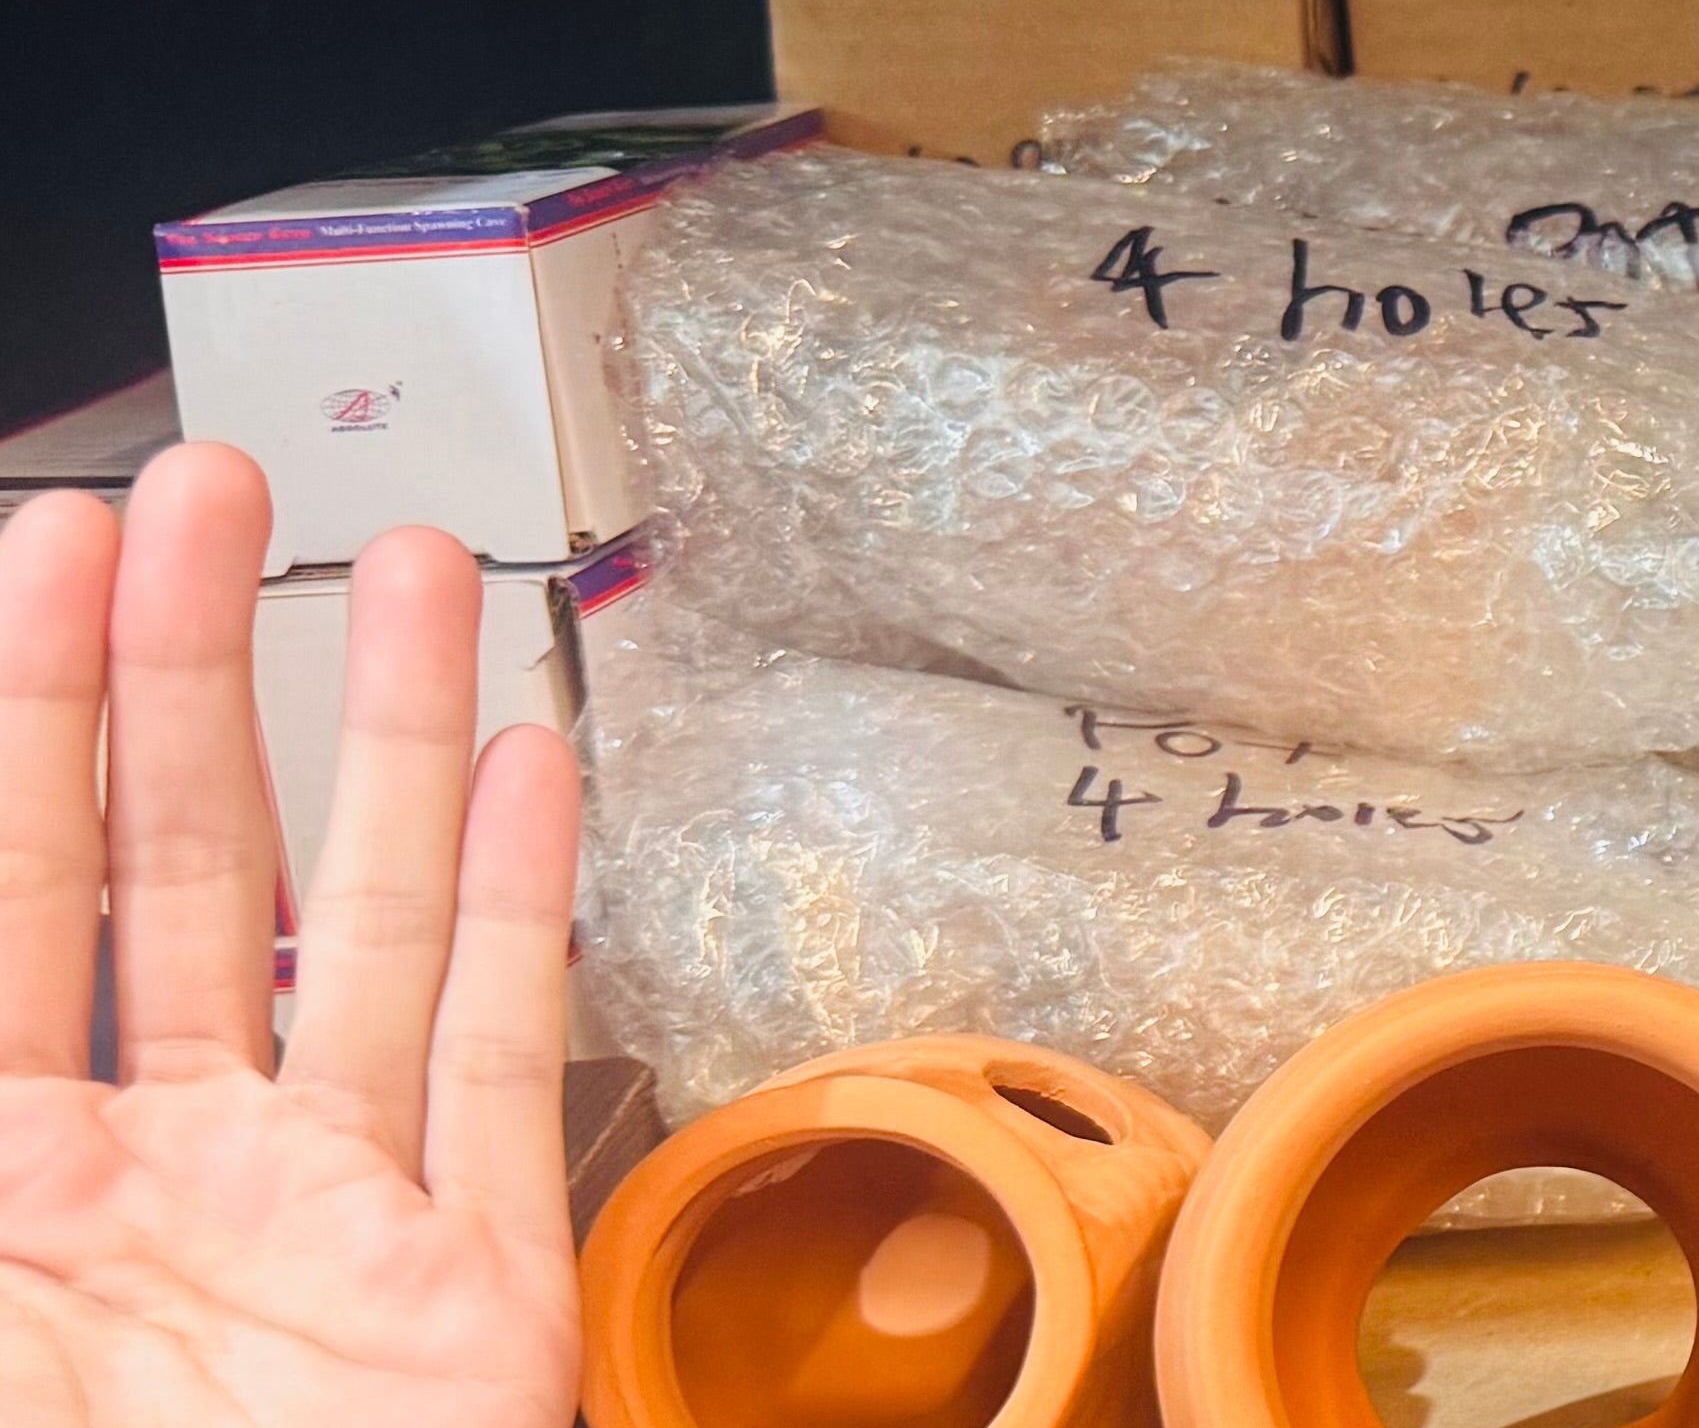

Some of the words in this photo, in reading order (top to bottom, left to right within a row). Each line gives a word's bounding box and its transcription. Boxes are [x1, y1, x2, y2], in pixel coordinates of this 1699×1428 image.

[1092, 226, 1221, 329] 4
[1281, 238, 1628, 341] holes
[1066, 766, 1164, 843] 4
